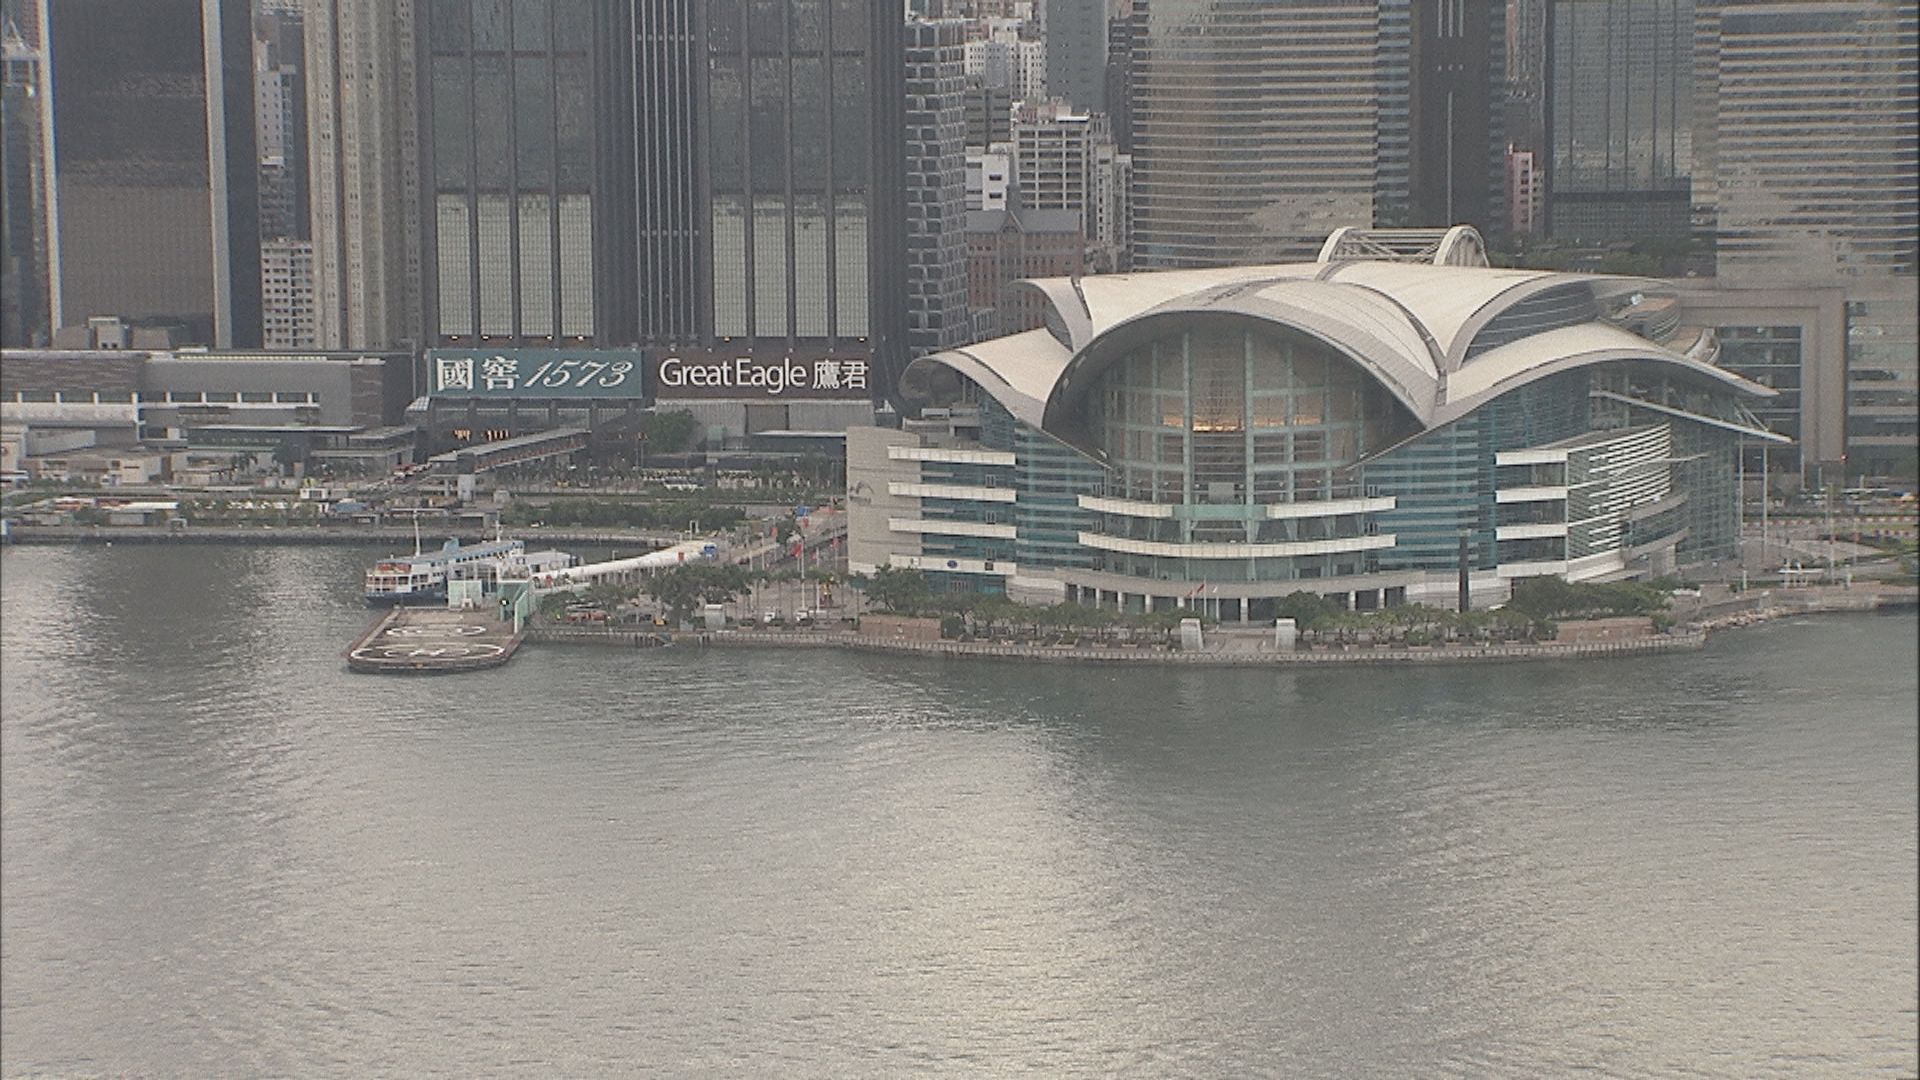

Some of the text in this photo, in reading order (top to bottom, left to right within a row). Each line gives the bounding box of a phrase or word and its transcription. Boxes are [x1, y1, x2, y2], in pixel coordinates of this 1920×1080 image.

[437, 357, 634, 391] 國窖 1573
[659, 358, 869, 393] Great Eagle 鷹君
